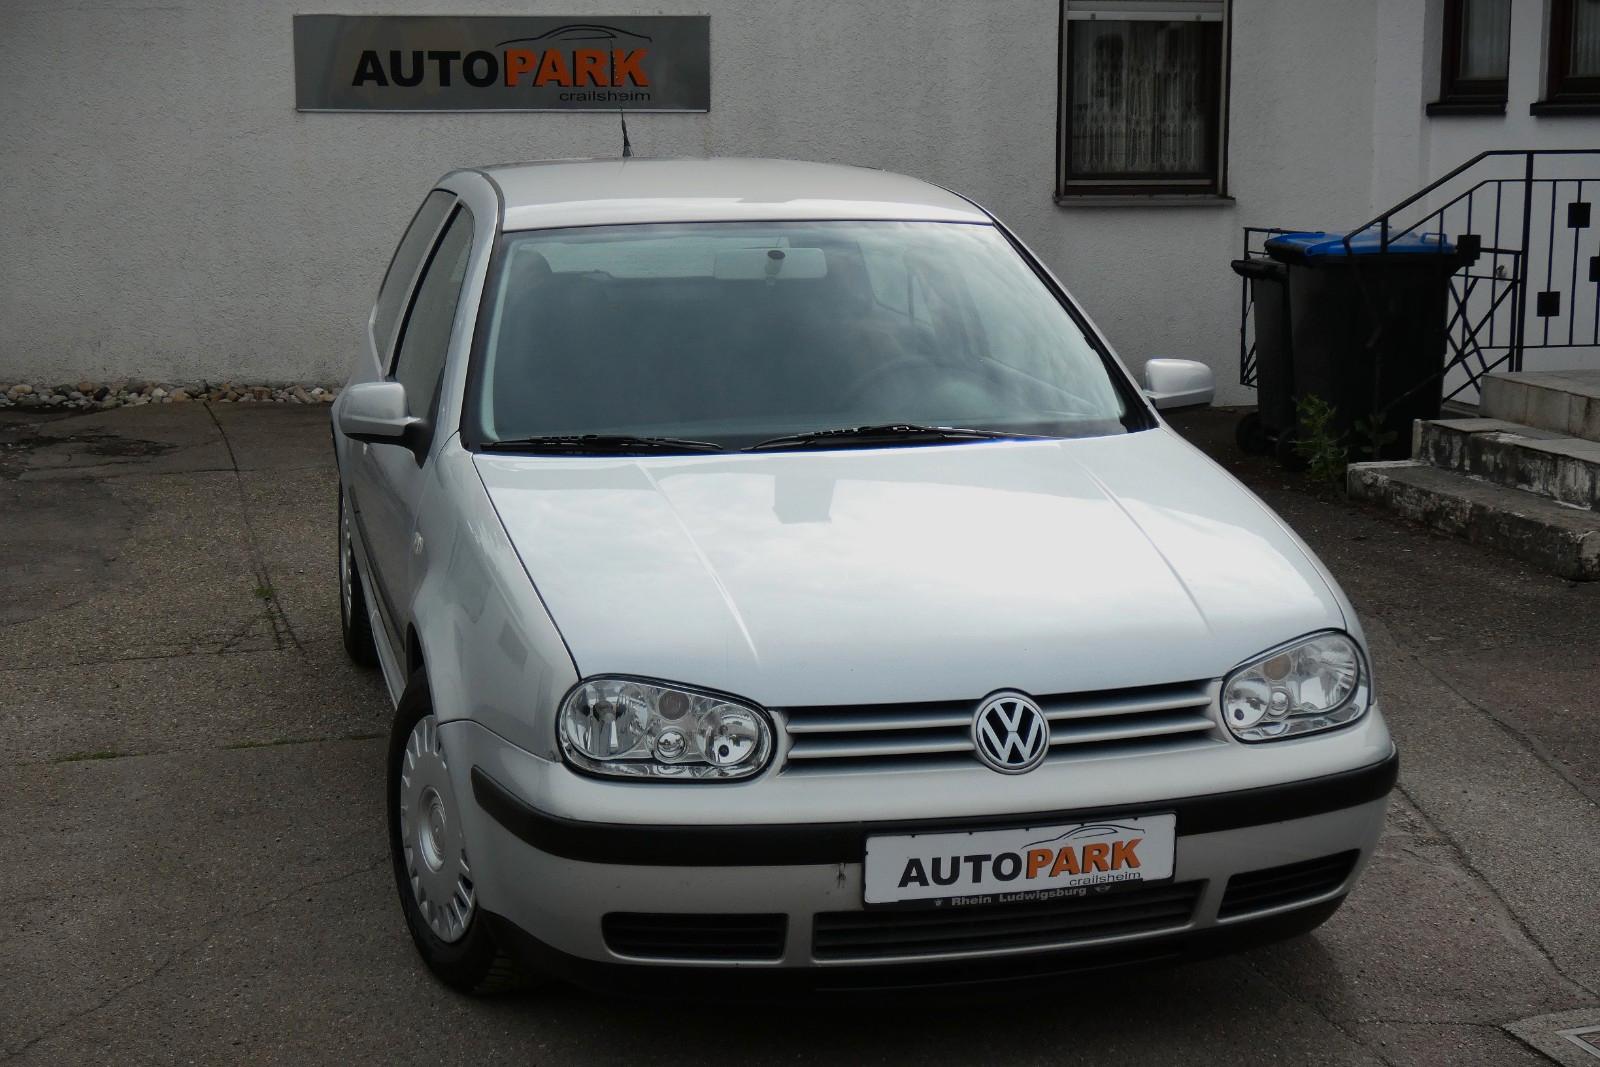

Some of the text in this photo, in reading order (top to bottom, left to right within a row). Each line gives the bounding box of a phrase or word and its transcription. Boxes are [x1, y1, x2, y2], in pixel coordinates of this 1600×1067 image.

[351, 49, 649, 88] AUTOPARK
[558, 91, 651, 102] crailsheim
[978, 697, 1045, 767] VW
[897, 838, 1142, 888] AUTOPARK
[1069, 870, 1141, 886] crailsheim
[951, 886, 1087, 907] Rhein Ludwigsburg
